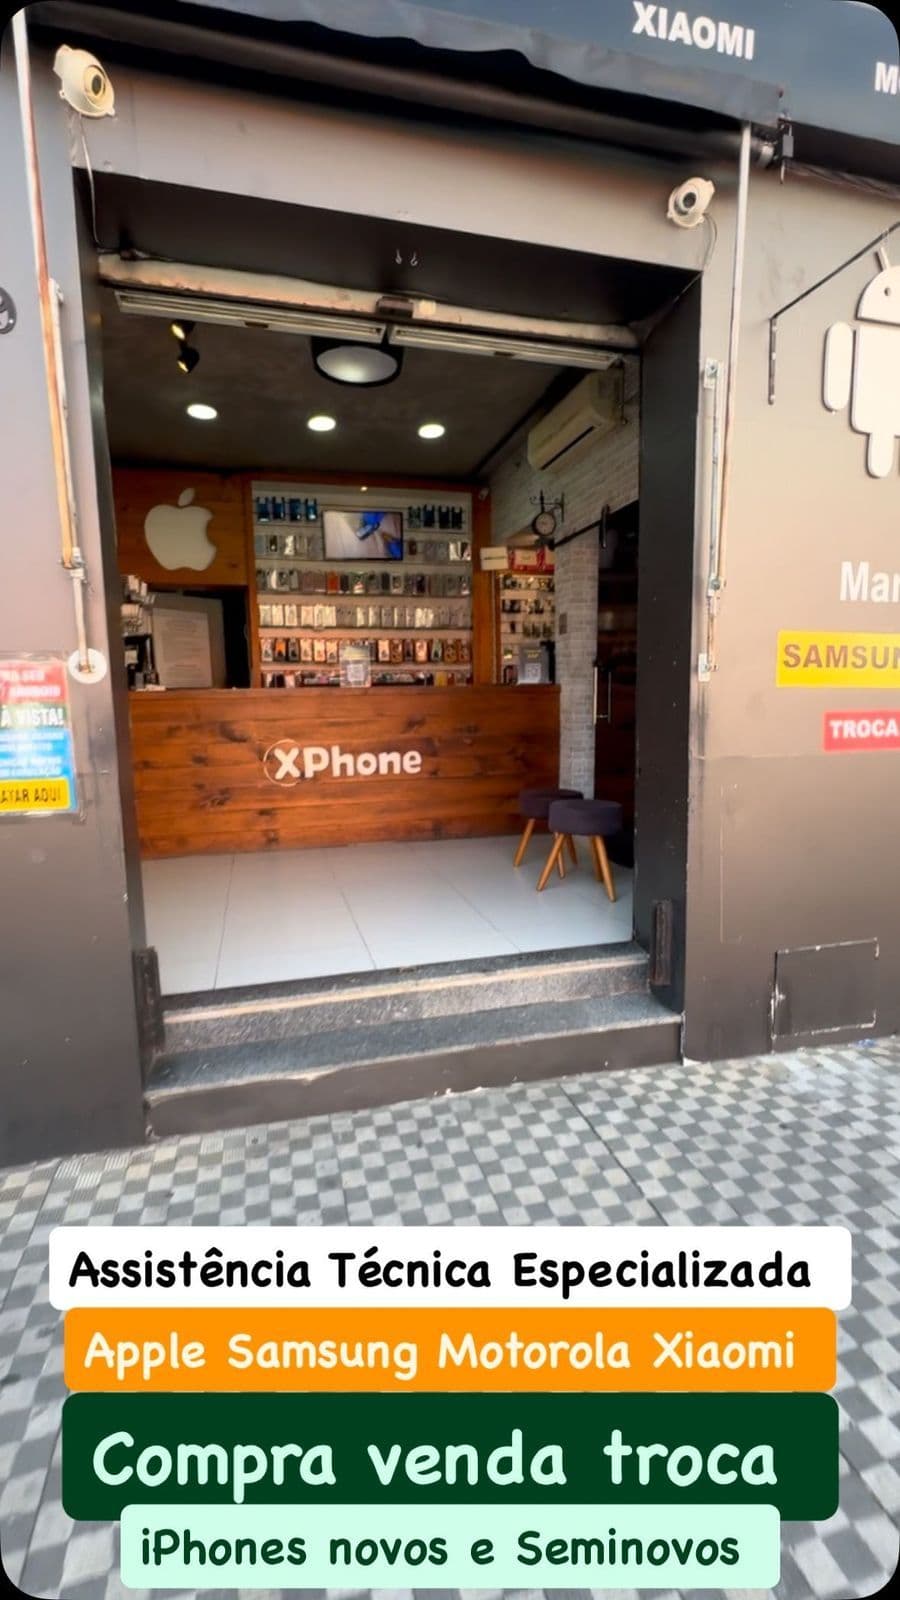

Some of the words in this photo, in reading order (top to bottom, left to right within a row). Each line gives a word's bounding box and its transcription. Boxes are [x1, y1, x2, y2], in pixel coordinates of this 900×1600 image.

[632, 1, 755, 60] XIAOMI
[875, 62, 900, 95] M
[829, 718, 899, 739] TROCA
[273, 745, 422, 780] XPhone
[34, 786, 61, 803] AQUI
